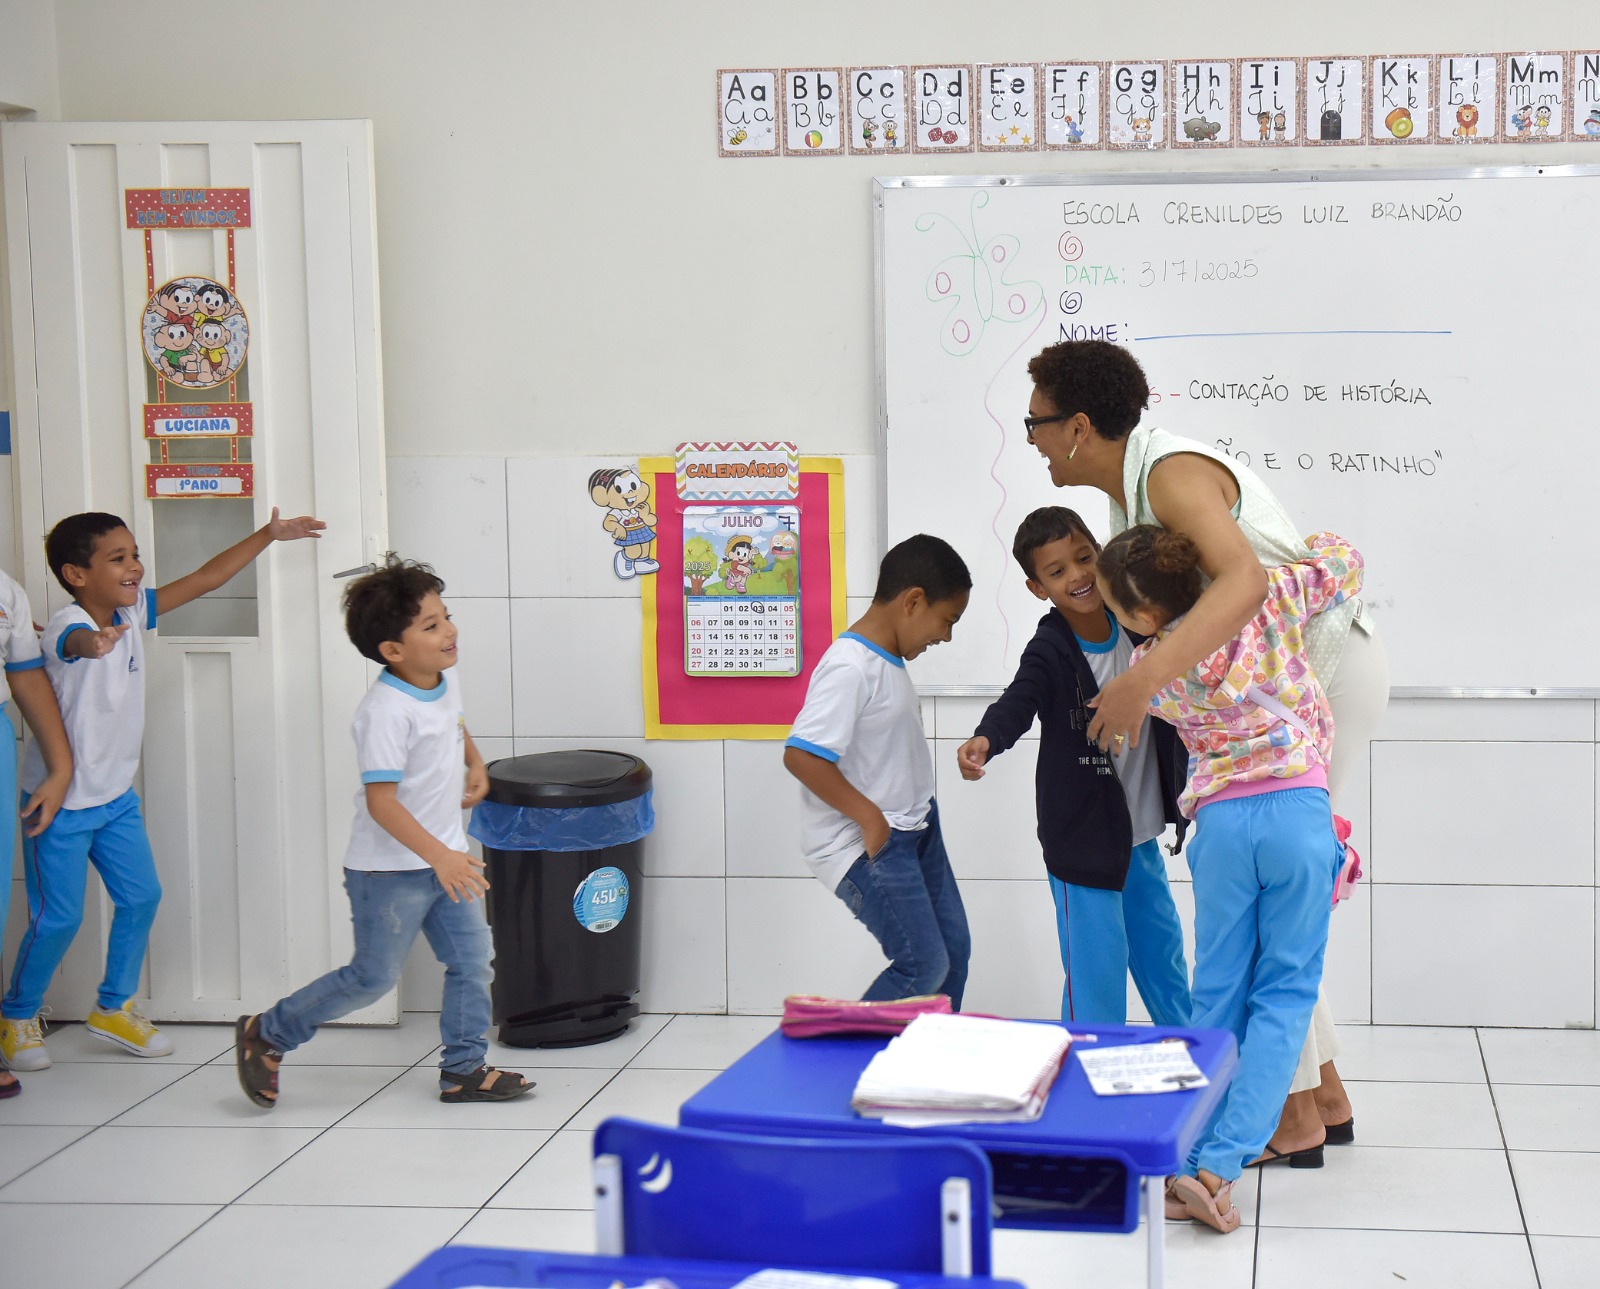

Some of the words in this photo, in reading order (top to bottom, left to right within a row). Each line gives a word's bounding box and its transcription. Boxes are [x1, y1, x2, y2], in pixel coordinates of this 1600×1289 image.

[160, 190, 206, 204] SEJAM
[1063, 201, 1140, 225] ESCOLA
[1163, 201, 1283, 225] CRENILDES
[1303, 204, 1348, 224] LUIZ
[1371, 193, 1462, 222] BRANDÃO
[137, 211, 167, 225] BEM
[182, 210, 237, 225] VINDOS
[1065, 264, 1126, 286] DATA:
[1059, 322, 1128, 342] NOME:
[1189, 374, 1289, 407] CONTAÇÃO
[1303, 384, 1328, 402] DE
[1341, 379, 1432, 405] HISTÓRIA
[165, 419, 231, 432] LUCIANA
[1263, 452, 1282, 470] E
[1297, 453, 1314, 470] O
[685, 460, 788, 480] CALENDÁRIO
[721, 515, 764, 529] JULHO
[684, 561, 712, 572] 2025
[690, 619, 702, 627] 06
[707, 619, 719, 627] 07
[723, 619, 734, 627] 08
[738, 619, 749, 627] 09
[753, 619, 763, 627] 10
[768, 619, 778, 627] 11
[784, 619, 794, 627] 12
[691, 633, 702, 641] 13
[708, 633, 719, 641] 14
[724, 633, 734, 641] 15
[739, 633, 749, 641] 16
[753, 633, 763, 641] 17
[768, 633, 779, 641] 18
[784, 633, 795, 641] 19
[691, 648, 702, 656] 20
[768, 648, 779, 656] 25
[784, 648, 795, 656] 26
[691, 661, 702, 669] 27
[708, 661, 719, 669] 28
[724, 661, 734, 669] 29
[738, 661, 749, 669] 30
[753, 661, 763, 669] 31
